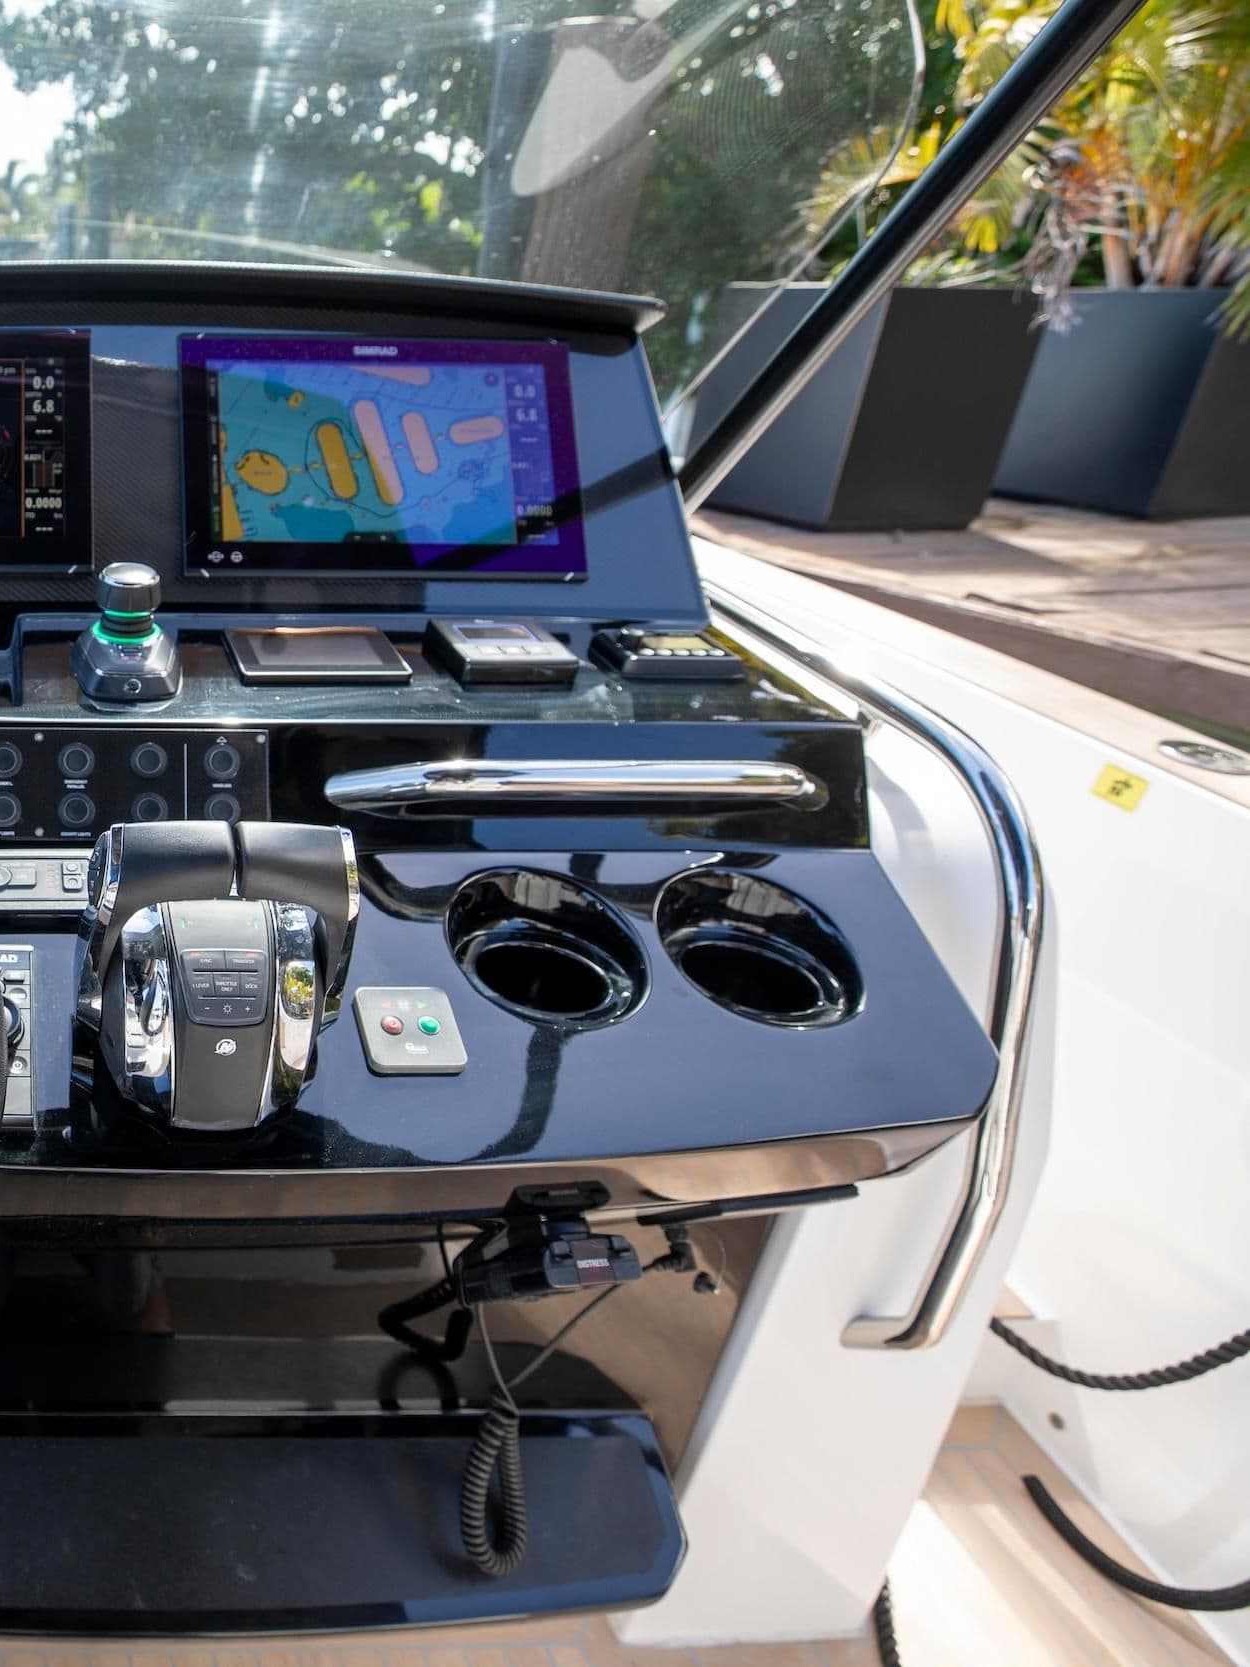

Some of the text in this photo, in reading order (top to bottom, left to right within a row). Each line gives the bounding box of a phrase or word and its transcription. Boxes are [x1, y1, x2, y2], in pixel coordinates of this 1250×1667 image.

[33, 376, 55, 390] 0.0
[33, 400, 55, 413] 6.8
[25, 497, 62, 509] 0.0000
[577, 1259, 609, 1268] DISTRESS
